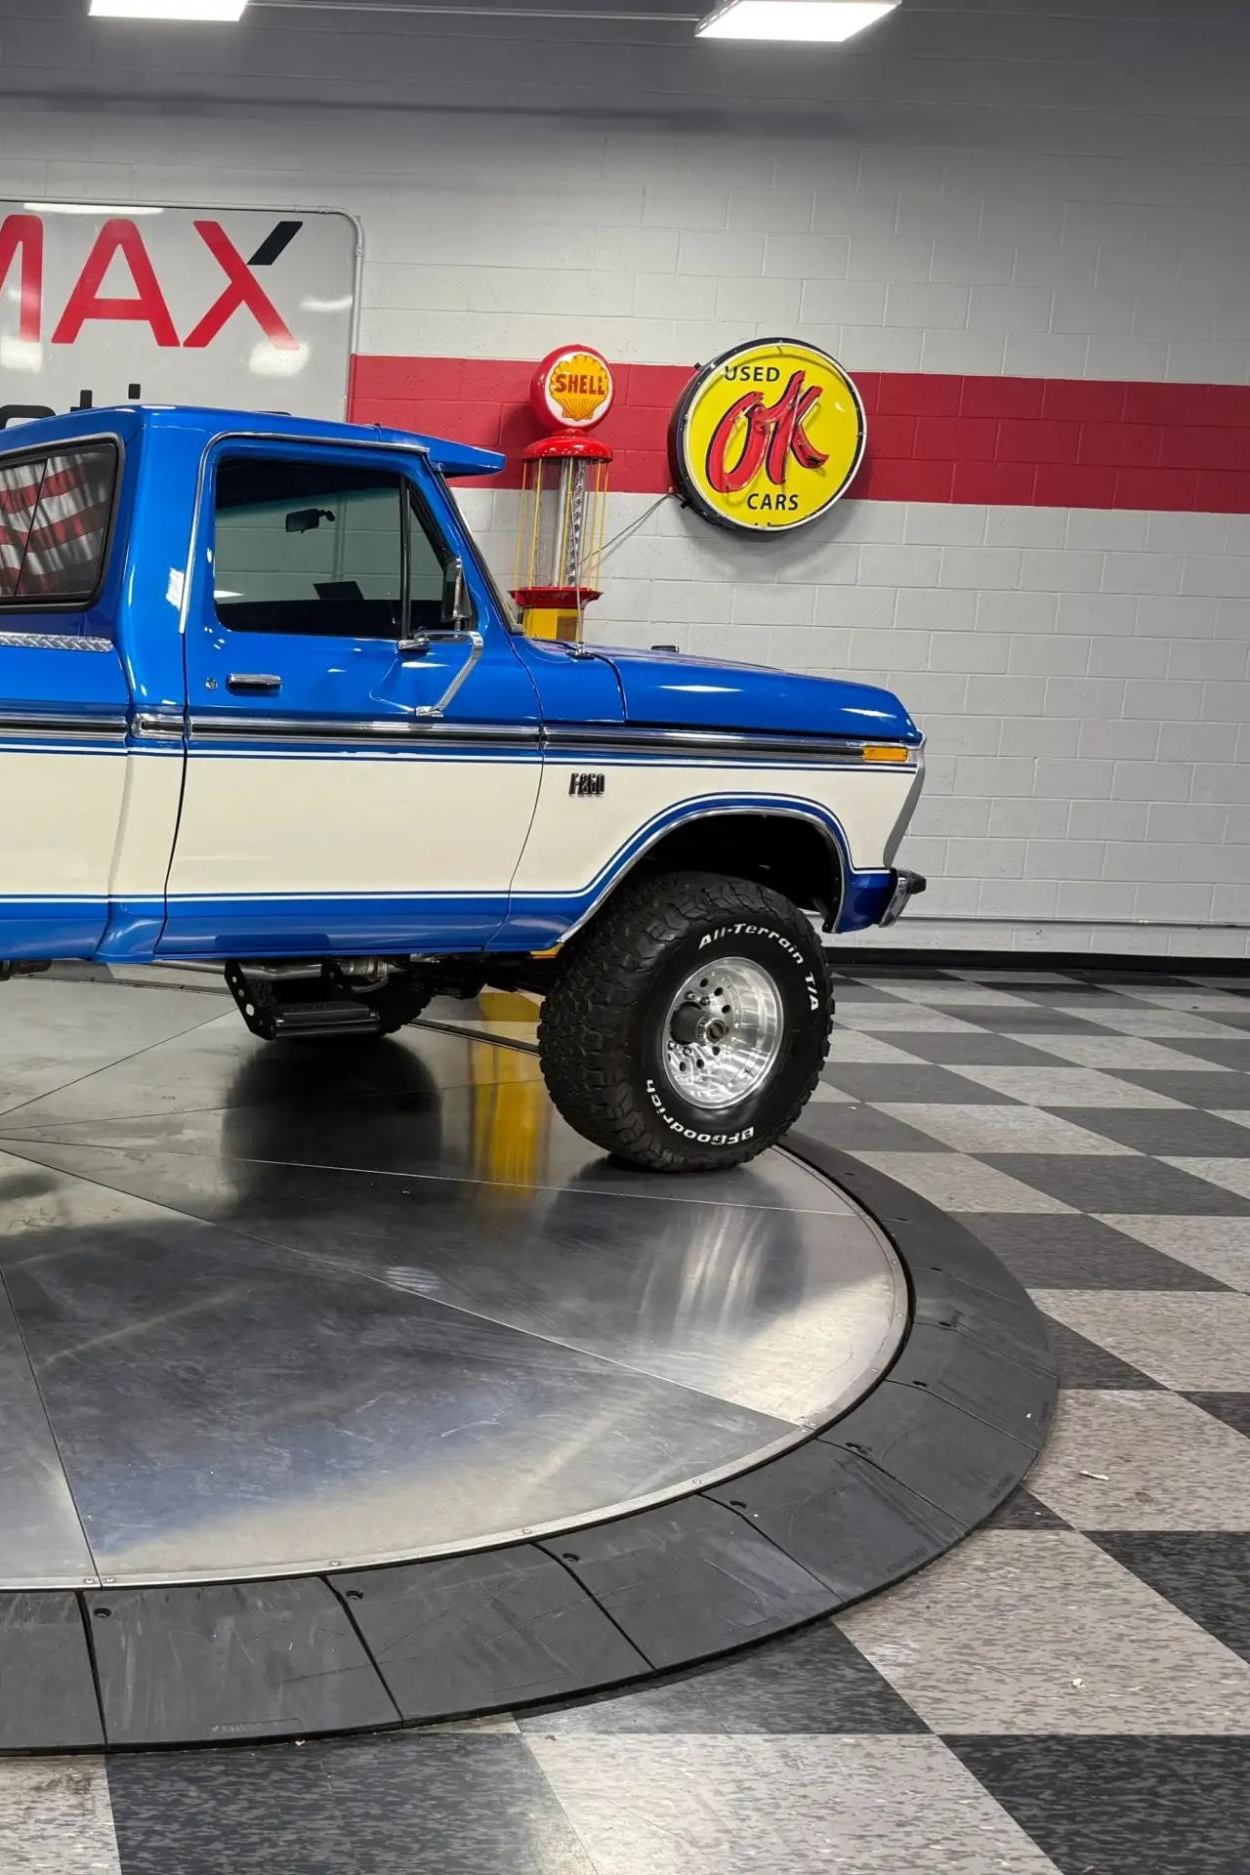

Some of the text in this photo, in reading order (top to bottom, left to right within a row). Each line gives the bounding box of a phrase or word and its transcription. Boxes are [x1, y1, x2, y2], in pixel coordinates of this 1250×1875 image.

[554, 374, 605, 396] SHELL
[725, 366, 780, 382] USED
[705, 370, 830, 493] OK
[747, 493, 798, 510] CARS
[698, 922, 819, 1011] All-Terrain T/A
[646, 1079, 754, 1145] BFGoodrich
